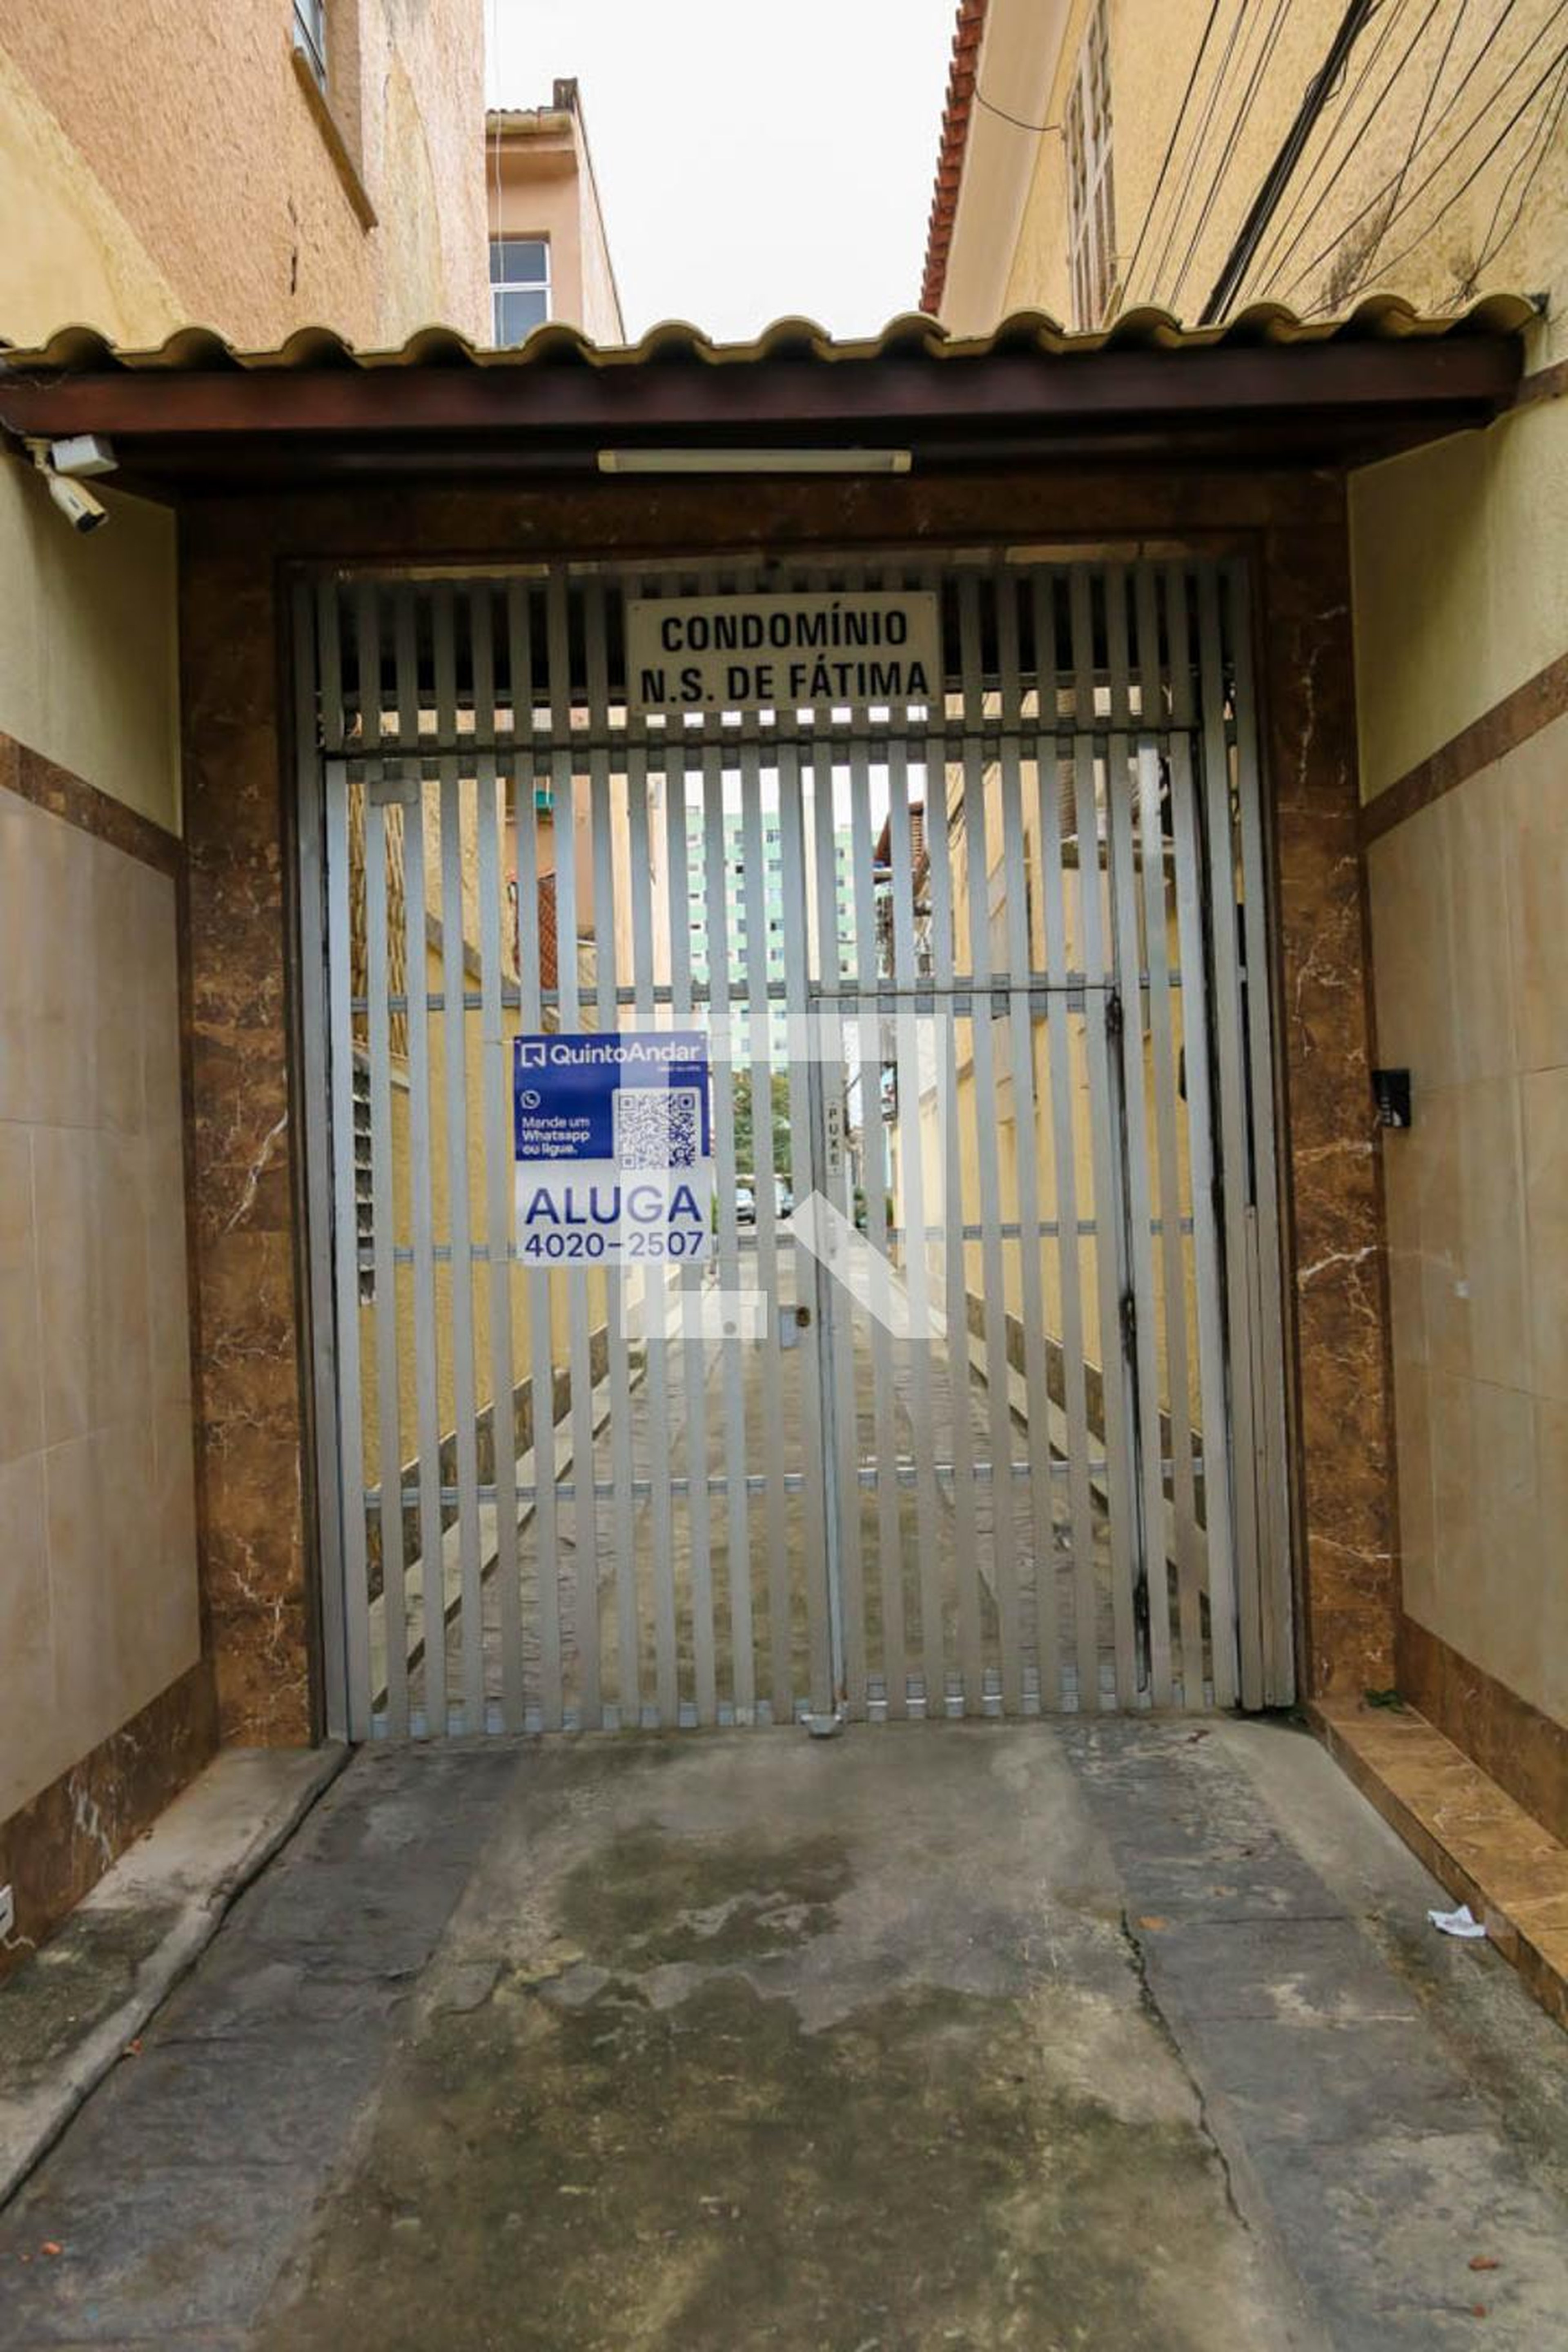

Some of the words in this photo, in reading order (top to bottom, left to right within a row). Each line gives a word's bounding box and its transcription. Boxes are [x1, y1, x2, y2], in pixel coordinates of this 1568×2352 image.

[661, 602, 908, 652] CONDOMÍNIO
[641, 668, 715, 704] N.S.
[728, 666, 774, 700] DE
[790, 654, 929, 699] FÁTIMA
[550, 1042, 700, 1064] QuintoAndar
[522, 1116, 567, 1128] Mande
[568, 1118, 590, 1128] um
[828, 1107, 840, 1165] PUXE
[522, 1145, 540, 1155] ou
[525, 1185, 702, 1225] ALUGA
[524, 1231, 704, 1257] 4020-2507
